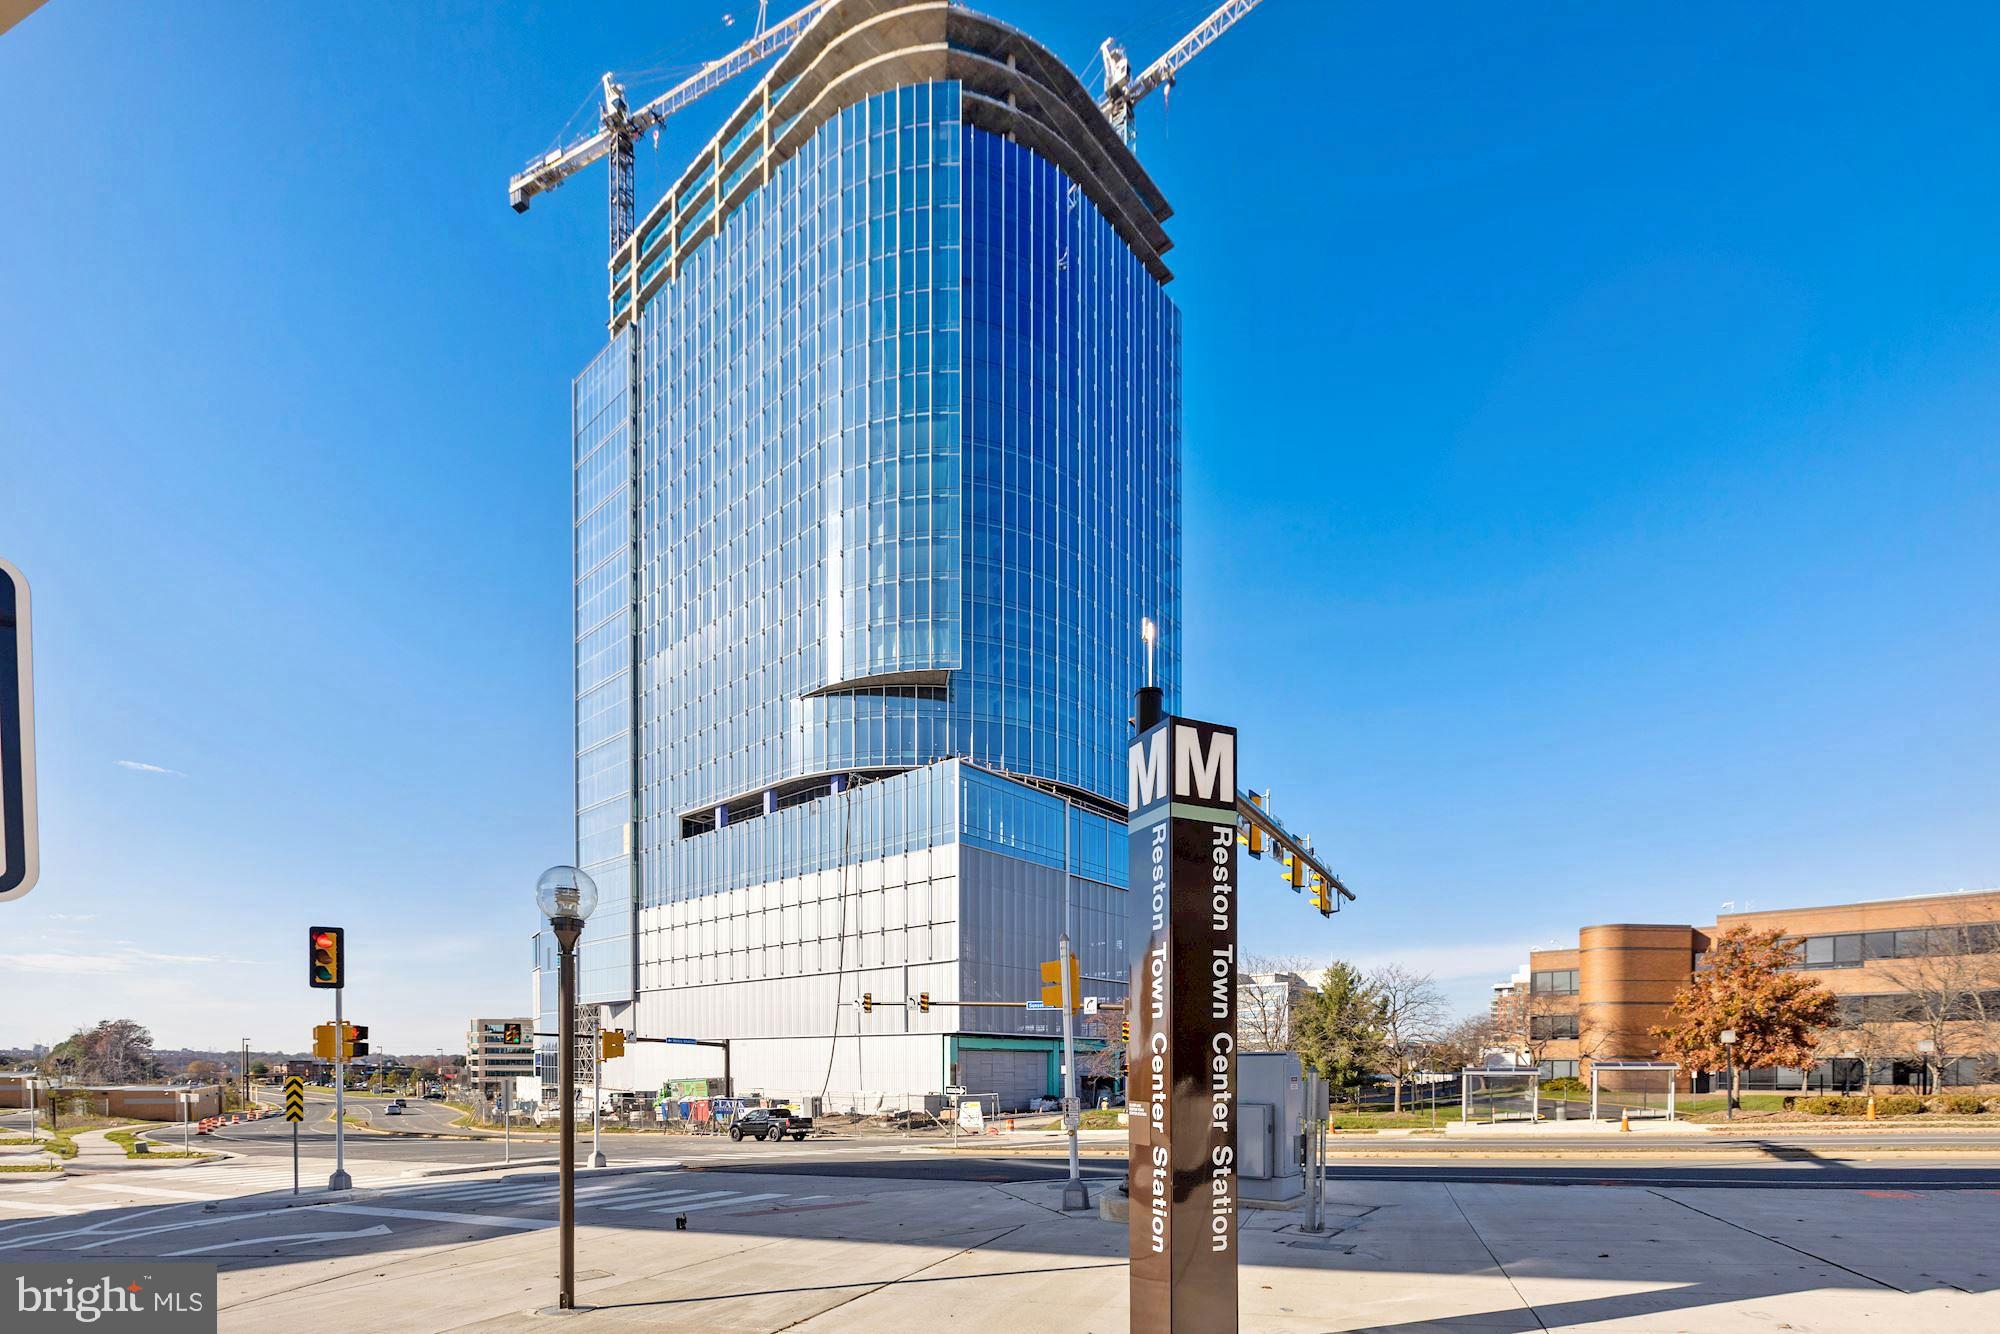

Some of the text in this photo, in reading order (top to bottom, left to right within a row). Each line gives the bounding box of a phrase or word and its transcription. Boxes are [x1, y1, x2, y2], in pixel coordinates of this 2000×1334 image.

[1128, 726, 1167, 813] M
[1175, 724, 1234, 803] M
[1152, 822, 1168, 1253] Reston Town Center Station
[1212, 825, 1234, 1252] Reston Town Center Station
